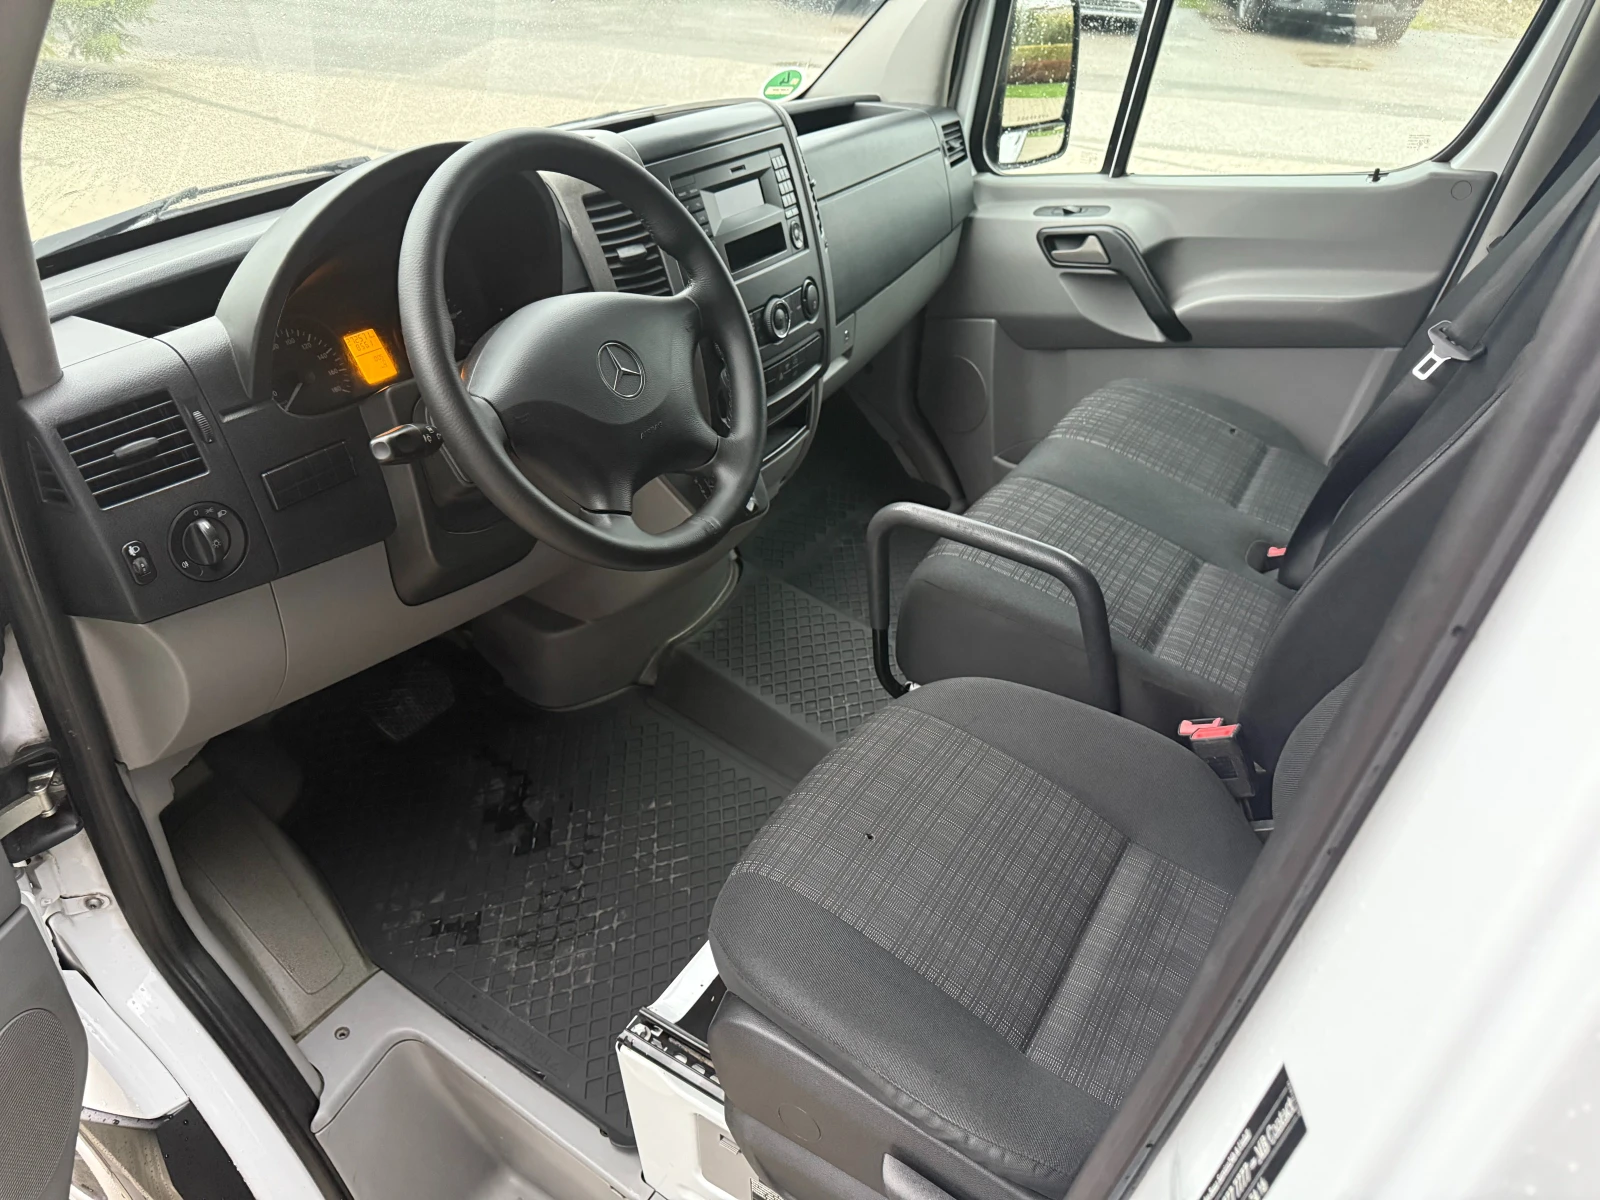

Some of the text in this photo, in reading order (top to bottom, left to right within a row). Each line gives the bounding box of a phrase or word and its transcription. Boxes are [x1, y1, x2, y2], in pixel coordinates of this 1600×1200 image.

[285, 337, 296, 346] 100
[301, 342, 312, 350] 120
[316, 353, 328, 361] 140
[328, 368, 339, 376] 160
[1265, 1096, 1298, 1146] Contact
